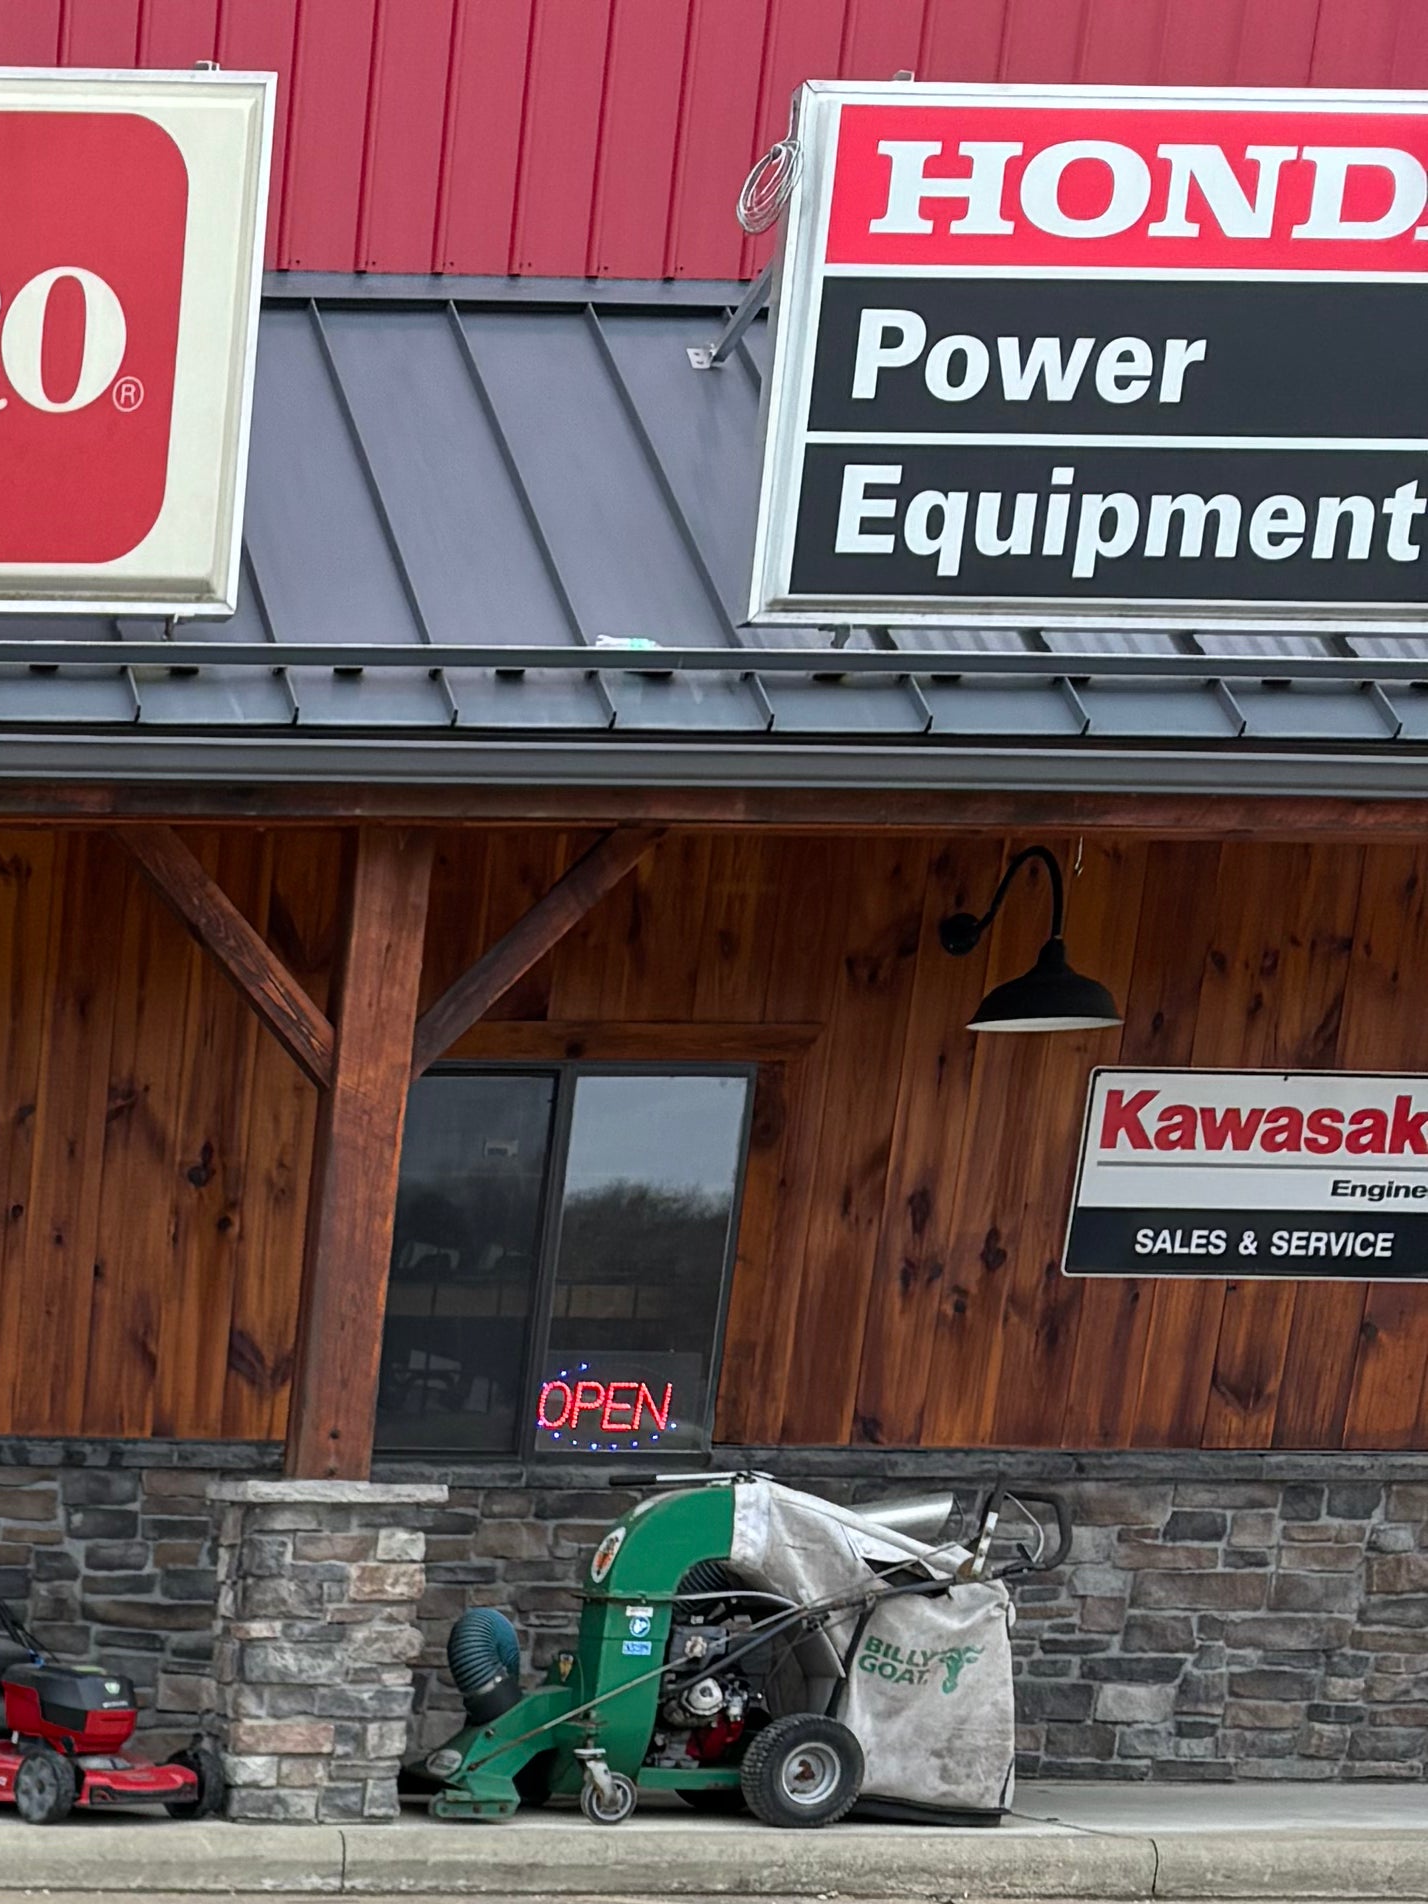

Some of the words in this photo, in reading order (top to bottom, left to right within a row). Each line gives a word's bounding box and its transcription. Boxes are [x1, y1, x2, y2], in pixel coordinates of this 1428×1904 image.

[868, 139, 1428, 242] HOND
[851, 308, 1207, 404] Power
[834, 463, 1427, 578] Equipment
[1134, 1228, 1227, 1256] SALES
[1238, 1231, 1258, 1256] &
[1270, 1231, 1395, 1259] SERVICE
[537, 1380, 674, 1432] OPEN
[864, 1634, 930, 1668] BILLY
